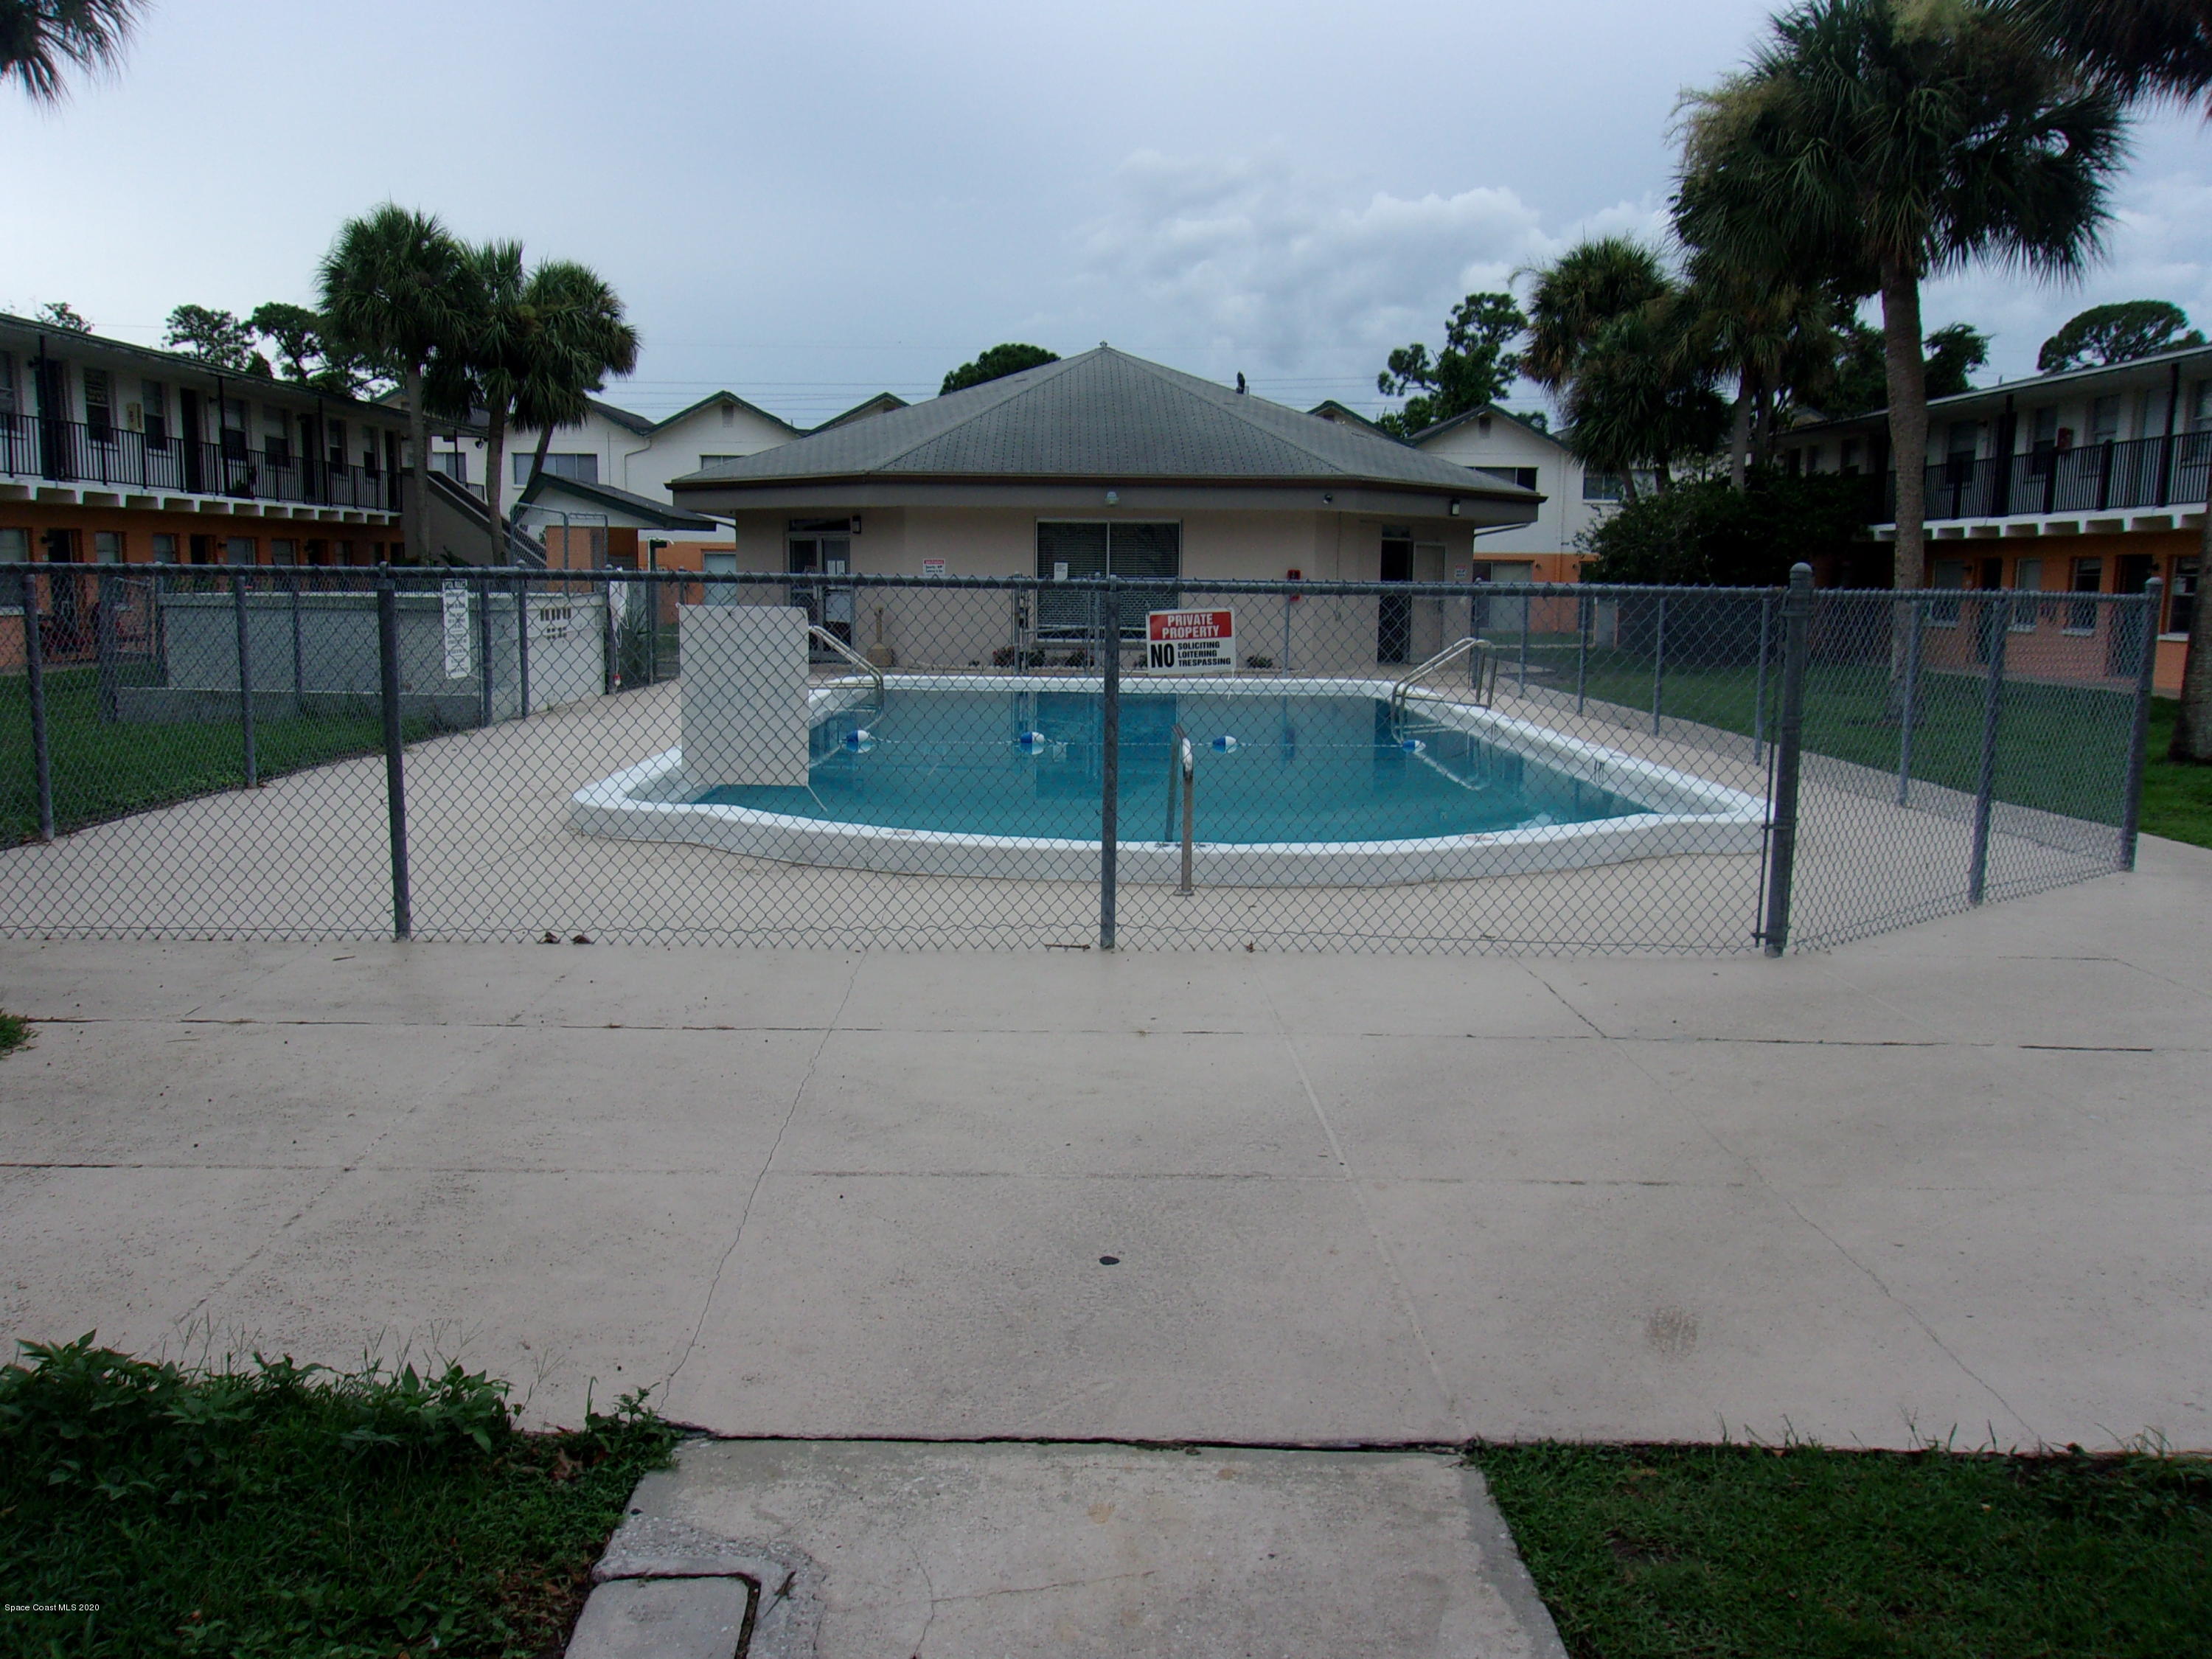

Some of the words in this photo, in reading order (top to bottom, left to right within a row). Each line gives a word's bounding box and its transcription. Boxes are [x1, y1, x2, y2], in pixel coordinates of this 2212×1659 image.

[1168, 613, 1213, 627] PRIVATE
[1162, 625, 1220, 639] PROPERTY
[1178, 641, 1220, 650] SOLICITING
[1150, 643, 1175, 668] NO
[1178, 650, 1217, 658] LOITERING
[1178, 658, 1231, 667] TRESPASSING
